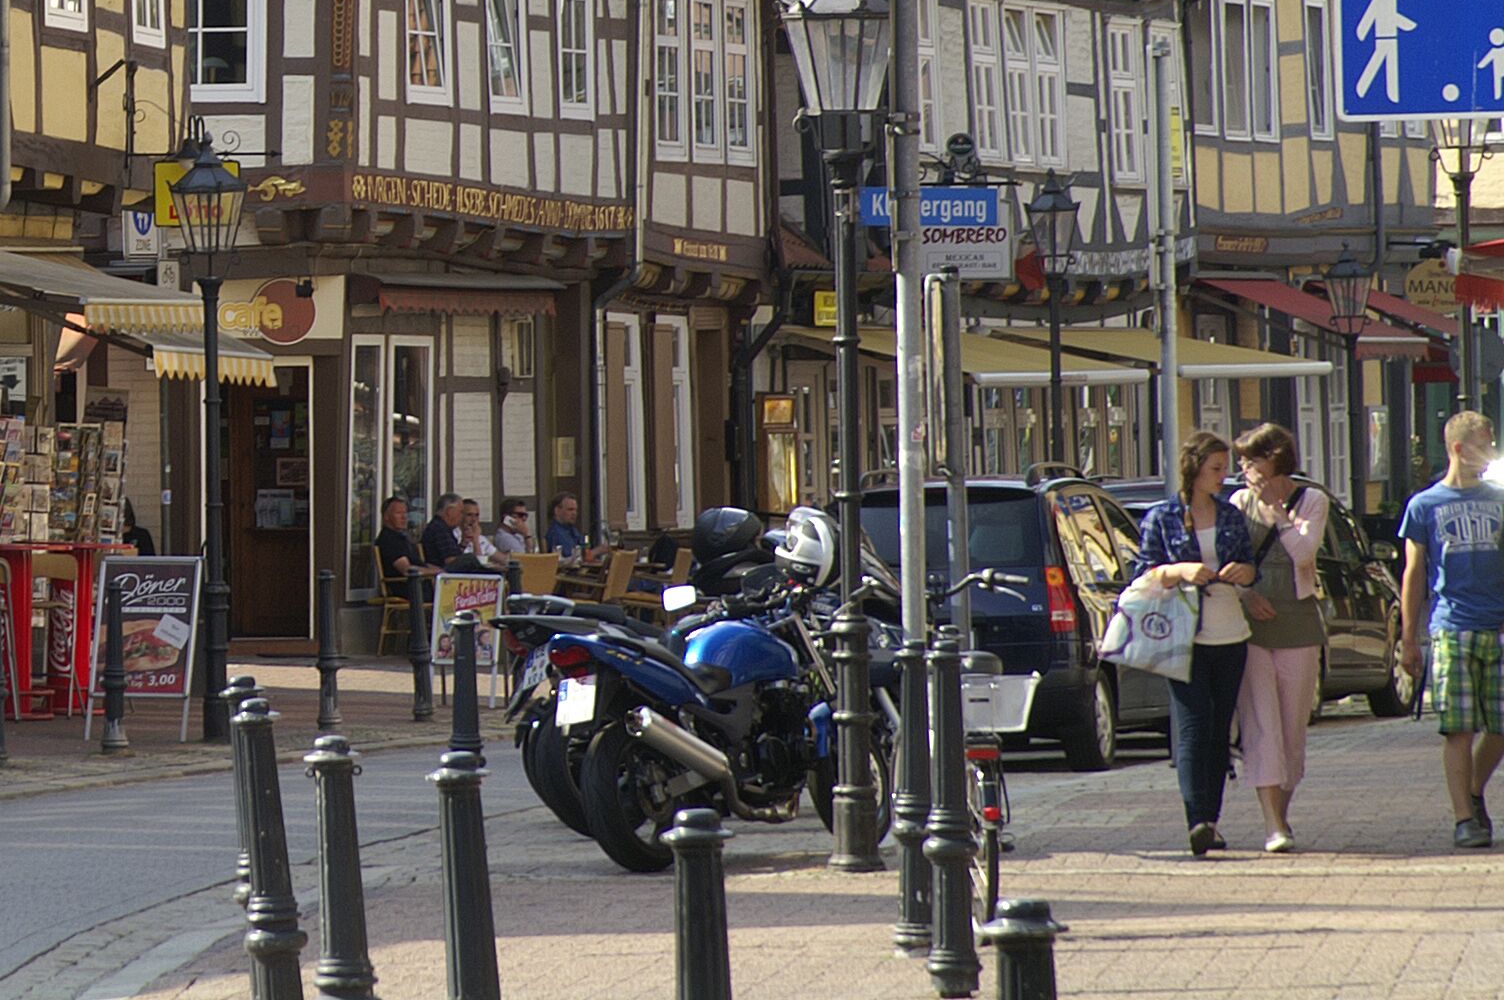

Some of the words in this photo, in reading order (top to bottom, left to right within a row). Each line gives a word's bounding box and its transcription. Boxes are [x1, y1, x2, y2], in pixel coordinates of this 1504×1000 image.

[169, 204, 224, 220] LOTTO
[871, 191, 987, 223] Klergang
[922, 226, 1007, 245] SOMBRERO
[217, 295, 284, 330] cafe
[146, 596, 186, 606] 2000
